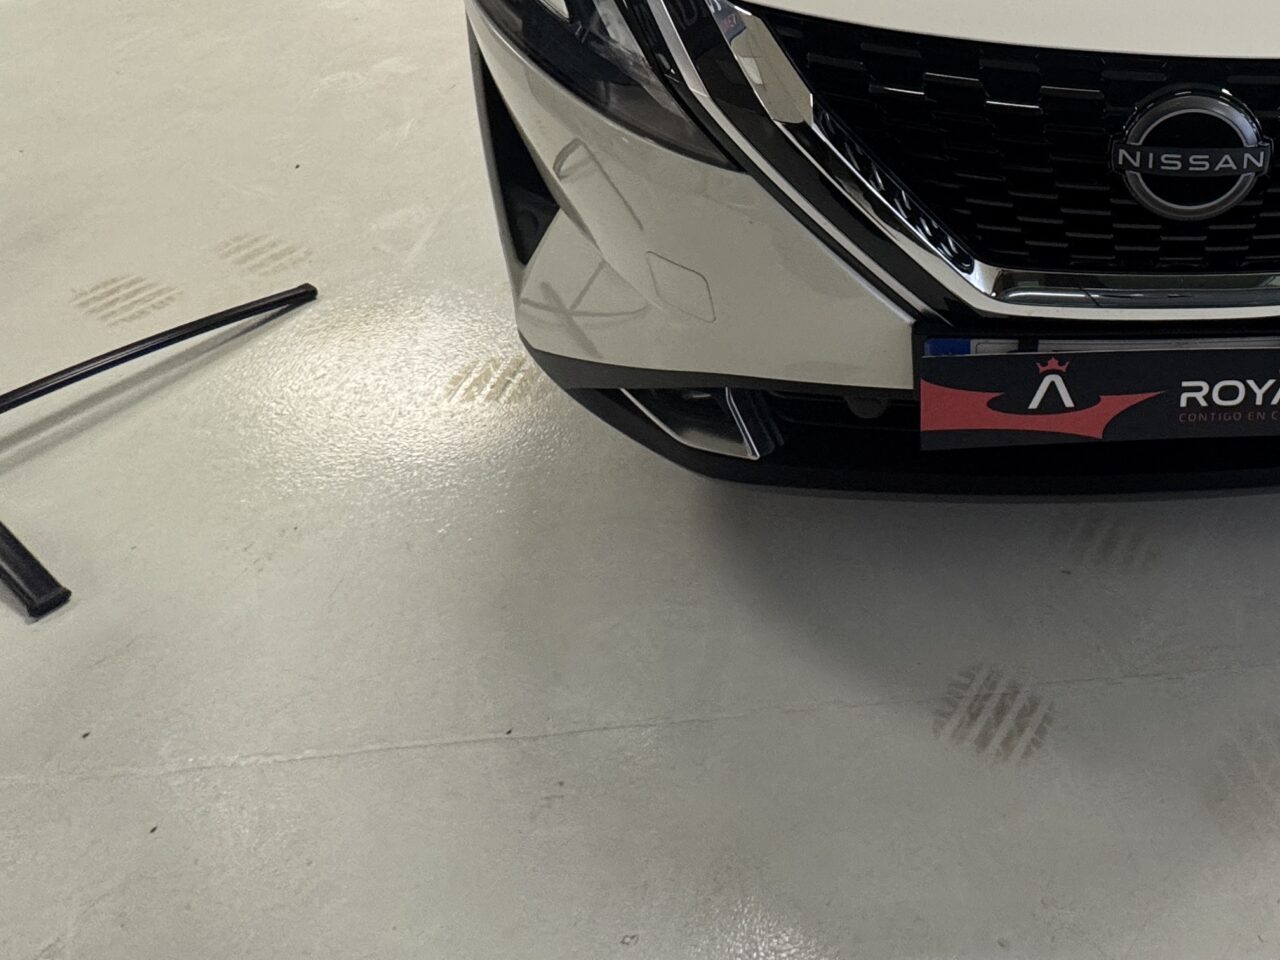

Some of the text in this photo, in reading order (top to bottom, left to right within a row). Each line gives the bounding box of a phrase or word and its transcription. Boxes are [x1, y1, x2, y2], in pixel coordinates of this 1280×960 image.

[1117, 148, 1265, 172] NISSAN
[1178, 411, 1243, 423] CONTIGO
[1247, 410, 1267, 421] EN
